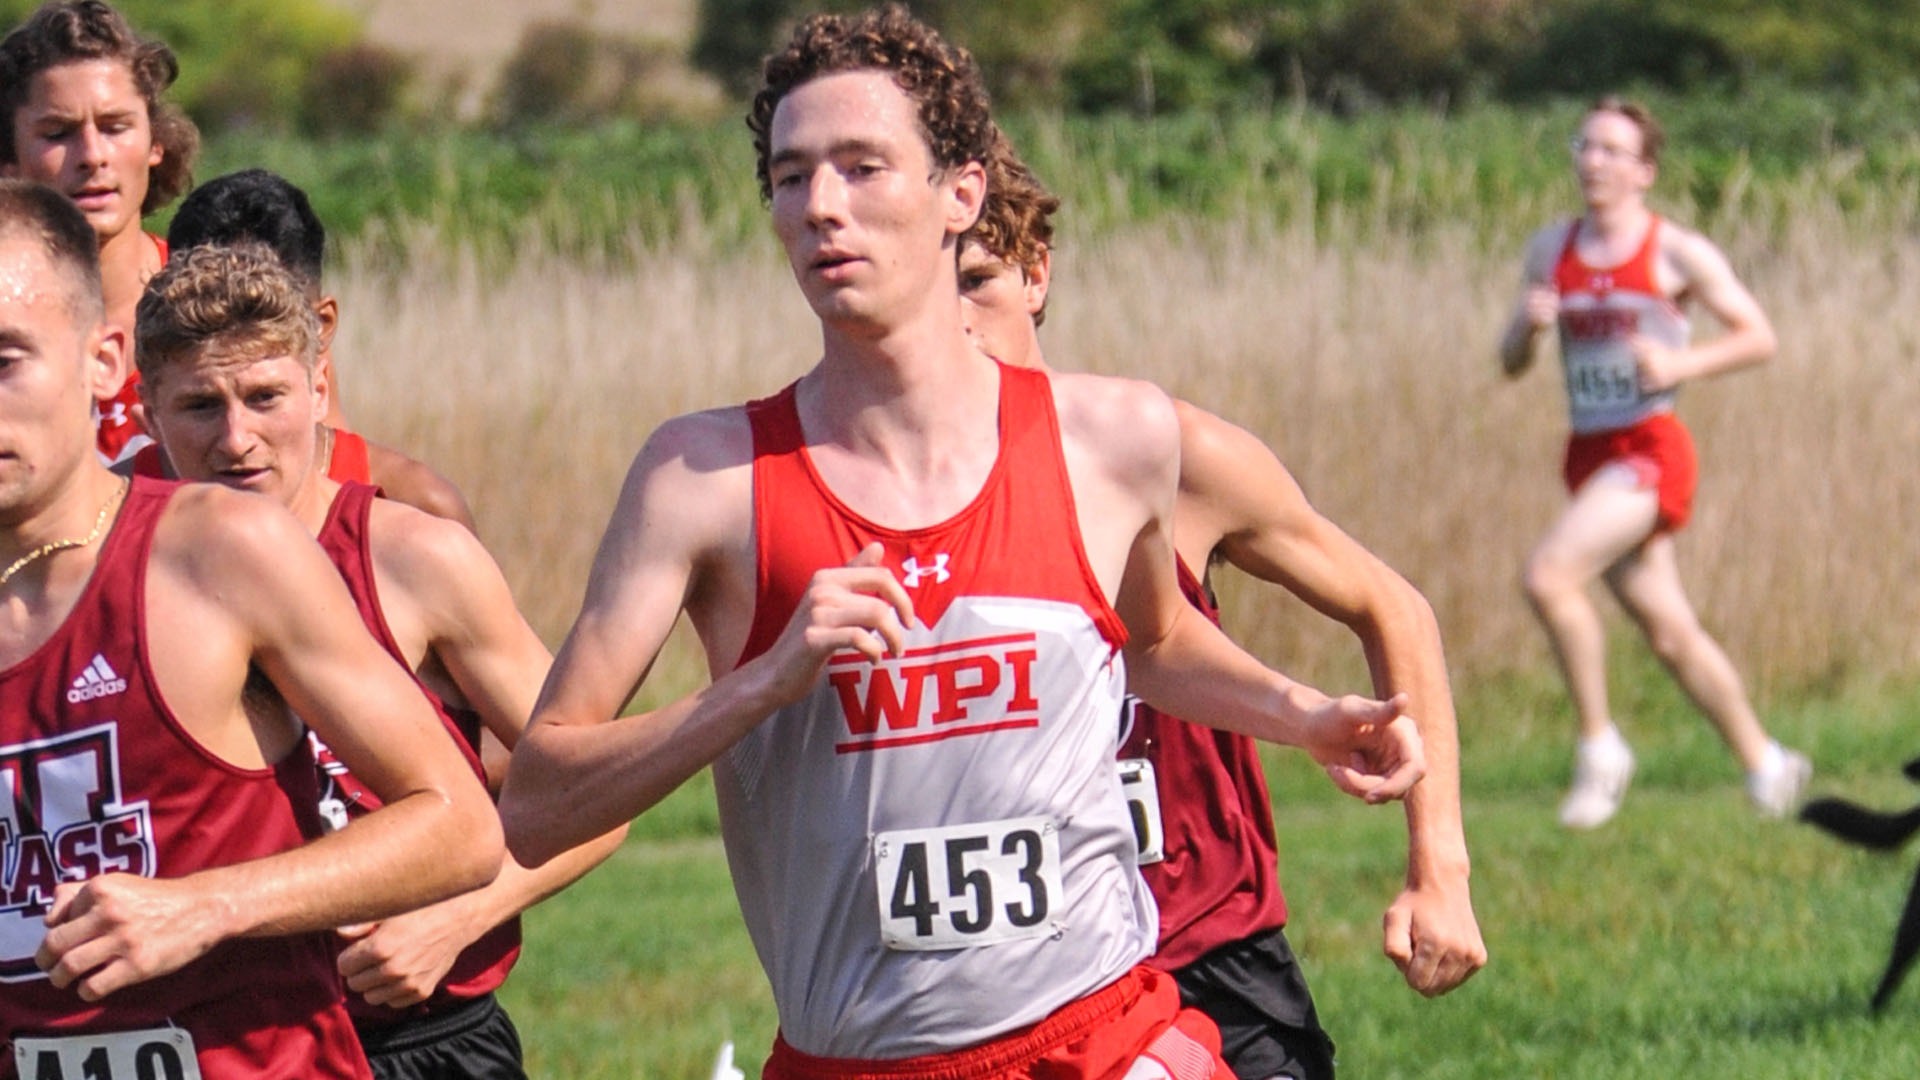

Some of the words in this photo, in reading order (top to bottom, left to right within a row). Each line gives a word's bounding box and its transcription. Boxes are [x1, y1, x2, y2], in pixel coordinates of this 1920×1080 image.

[67, 678, 127, 703] adidas
[829, 648, 1038, 736] WPI
[0, 816, 146, 905] ASS
[890, 829, 1049, 937] 453
